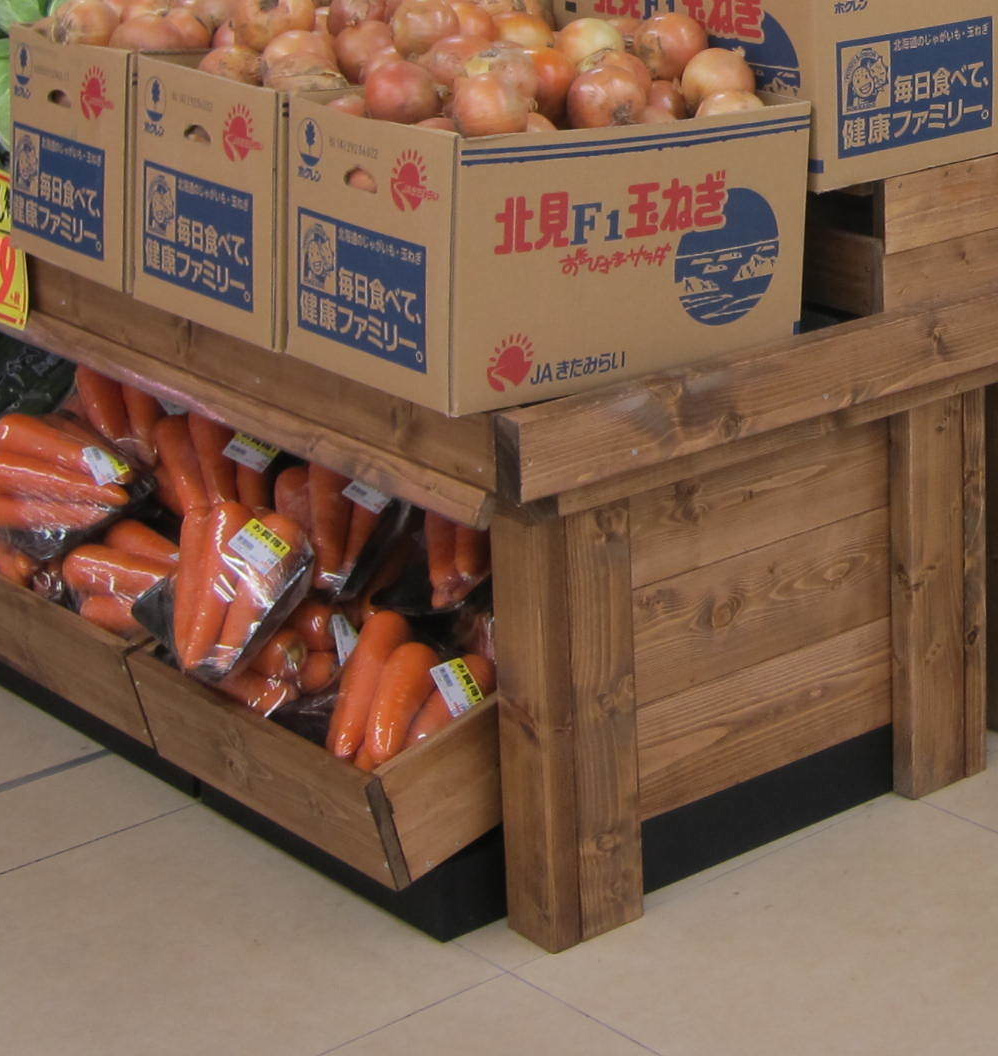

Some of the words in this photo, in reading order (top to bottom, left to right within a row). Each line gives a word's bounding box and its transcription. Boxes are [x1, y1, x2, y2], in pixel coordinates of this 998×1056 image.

[834, 0, 868, 14] ホクレン
[894, 60, 989, 103] 毎日食べて、
[842, 98, 990, 150] 健康ファミリー。
[13, 192, 103, 251] 健康ファミリー。
[40, 172, 101, 217] 毎日食べて、
[493, 170, 727, 255] 北見F1玉ねぎ
[177, 215, 250, 267] 毎日食べて、
[144, 239, 251, 302] 健康ファミリー。
[338, 267, 422, 324] 毎日食べて、
[300, 290, 425, 363] 健康ファミリー。
